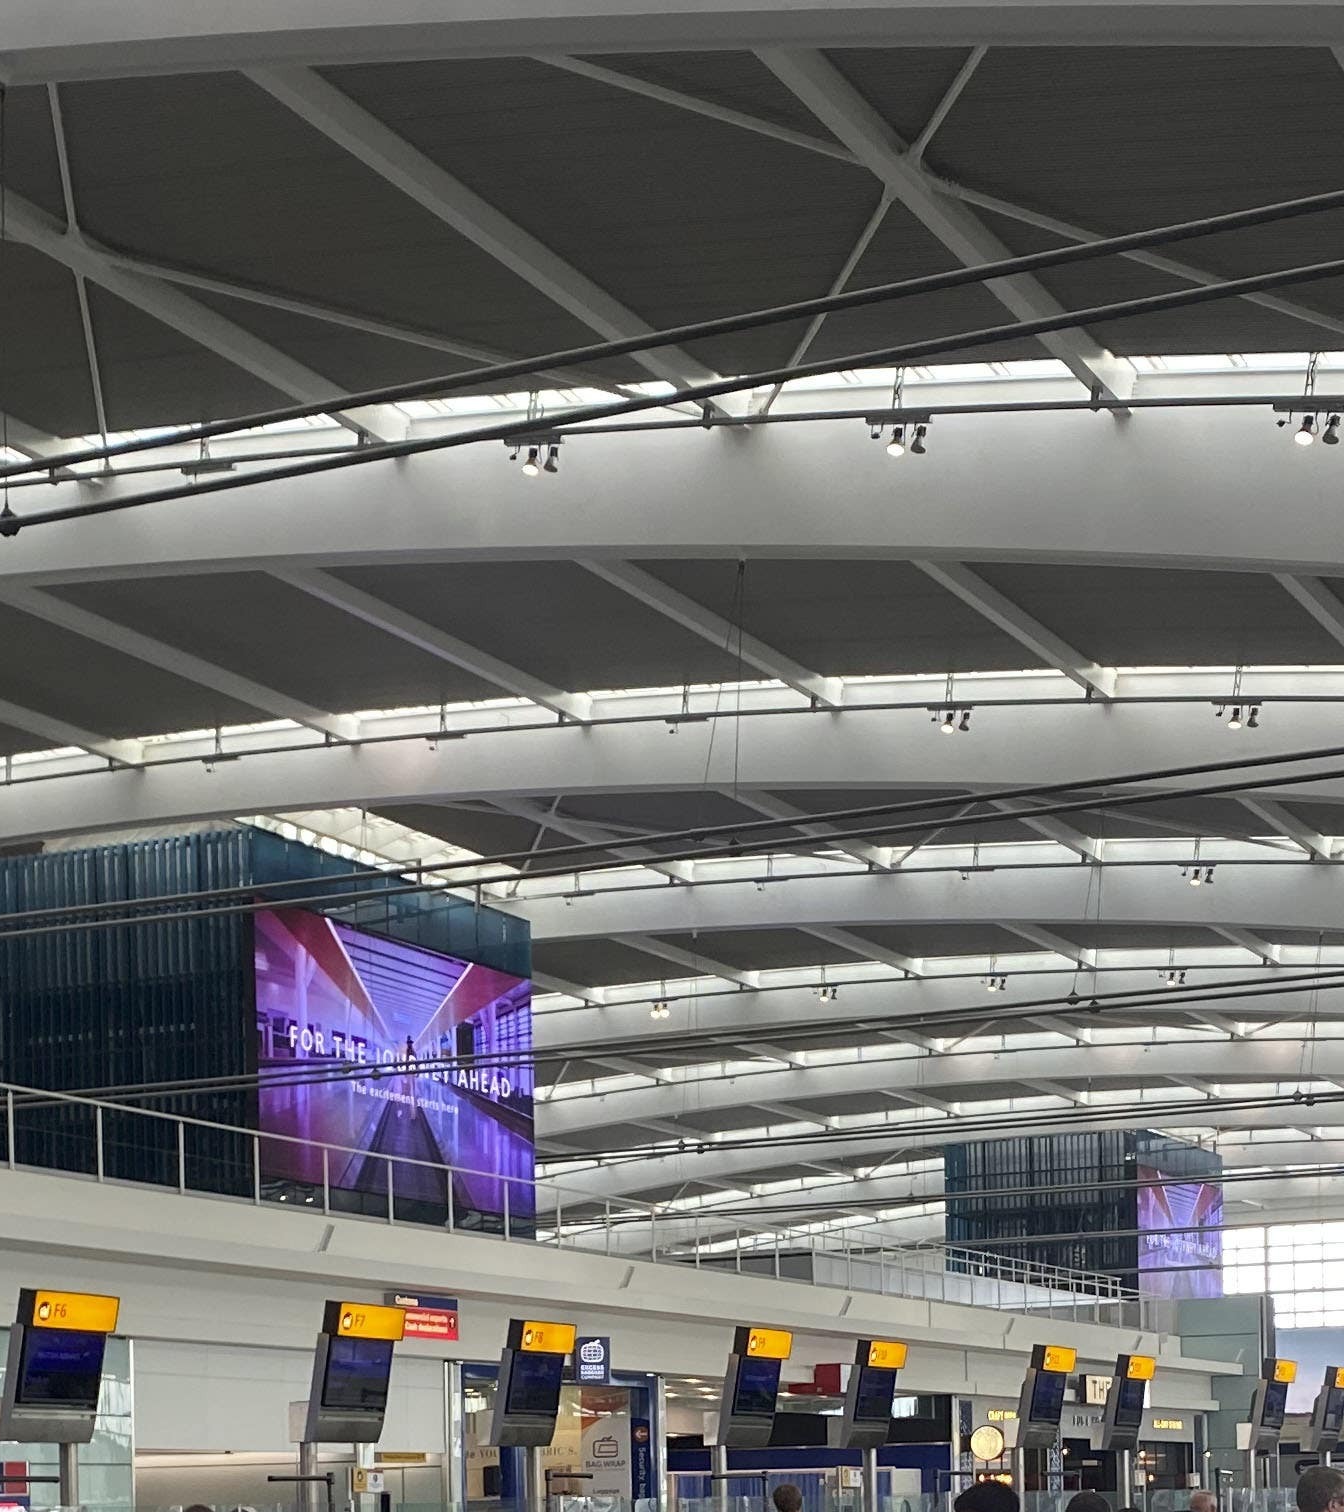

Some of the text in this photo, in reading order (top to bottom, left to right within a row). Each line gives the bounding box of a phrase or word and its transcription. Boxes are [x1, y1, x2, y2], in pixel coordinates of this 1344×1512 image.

[288, 1025, 325, 1055] FOR
[333, 1035, 366, 1066] THE
[457, 1069, 511, 1098] AHEAD
[353, 1081, 367, 1095] The
[53, 1303, 68, 1318] F6
[585, 1460, 626, 1469] BAG WRAP
[638, 1447, 647, 1481] Security
